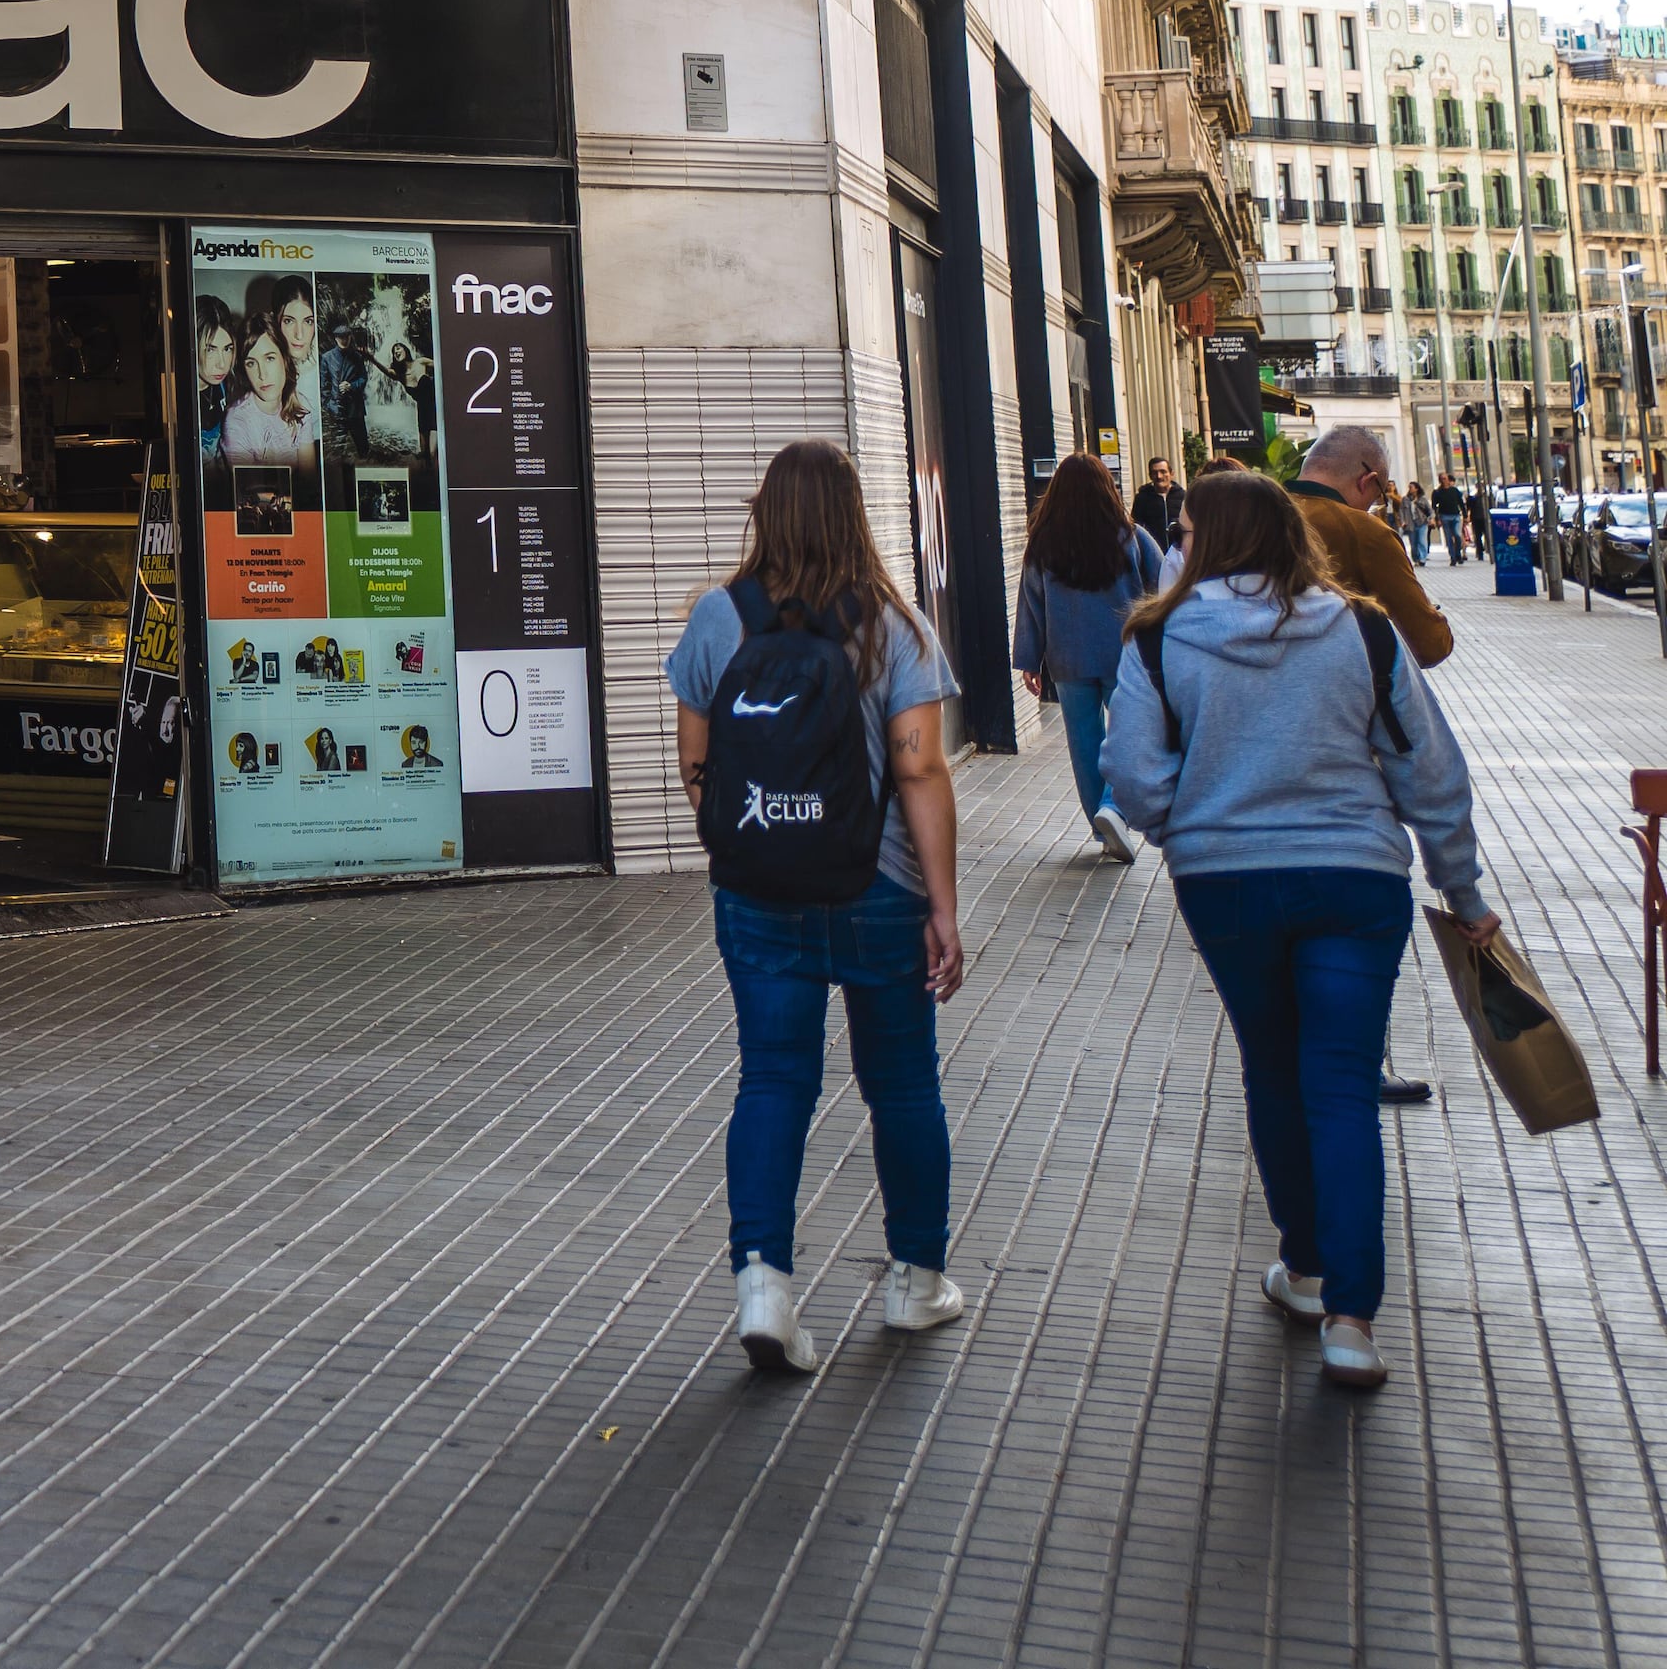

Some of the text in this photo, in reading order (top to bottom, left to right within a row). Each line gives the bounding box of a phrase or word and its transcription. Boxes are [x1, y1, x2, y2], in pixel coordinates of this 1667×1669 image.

[1619, 27, 1667, 60] HOT
[194, 239, 314, 261] Agenda fnac
[373, 246, 429, 257] BARCELONA
[452, 273, 553, 315] fnac
[465, 346, 503, 414] 2
[150, 474, 167, 491] QUE
[477, 506, 498, 573] 1
[373, 548, 399, 556] DIJOUS
[143, 555, 170, 569] TE PILLE
[267, 570, 293, 578] Triangle
[386, 569, 413, 578] Triangle
[248, 581, 286, 593] Cariño
[367, 580, 407, 592] Amaral
[370, 595, 390, 603] Dolce
[481, 670, 518, 737] 0
[766, 793, 822, 803] RAFA NADAL
[766, 802, 824, 822] CLUB
